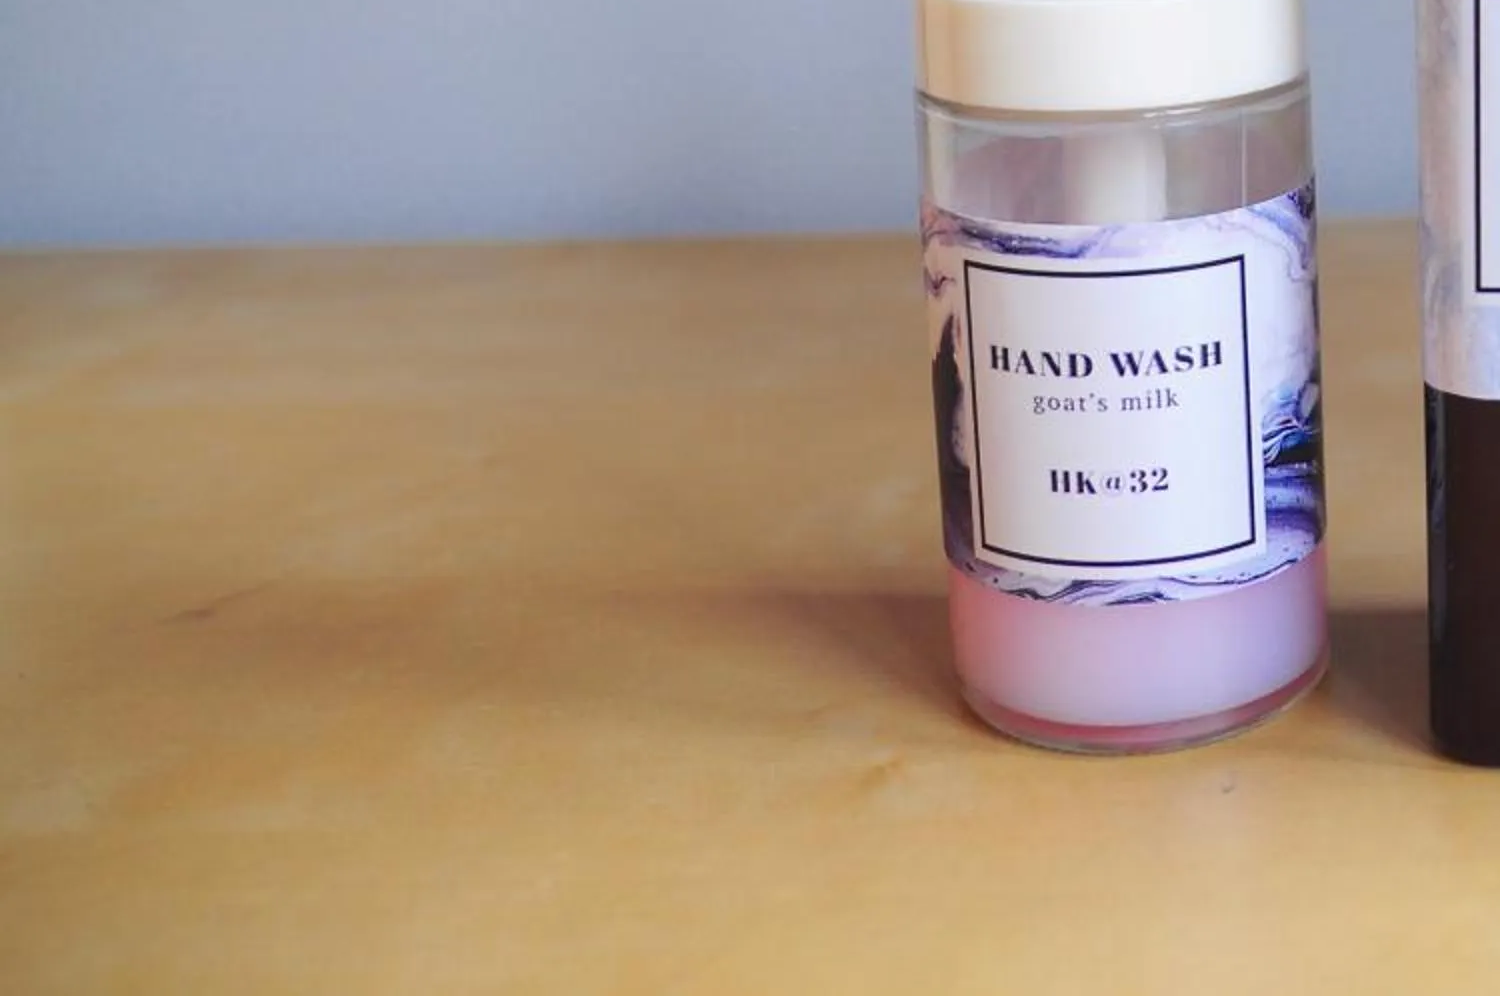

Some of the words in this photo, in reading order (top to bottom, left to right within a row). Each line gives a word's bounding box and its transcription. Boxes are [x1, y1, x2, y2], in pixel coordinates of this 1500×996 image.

[989, 342, 1094, 379] HAND
[1109, 339, 1224, 380] WASH
[1031, 393, 1109, 416] goat's
[1119, 387, 1180, 413] milk
[1049, 467, 1170, 496] HK@32
